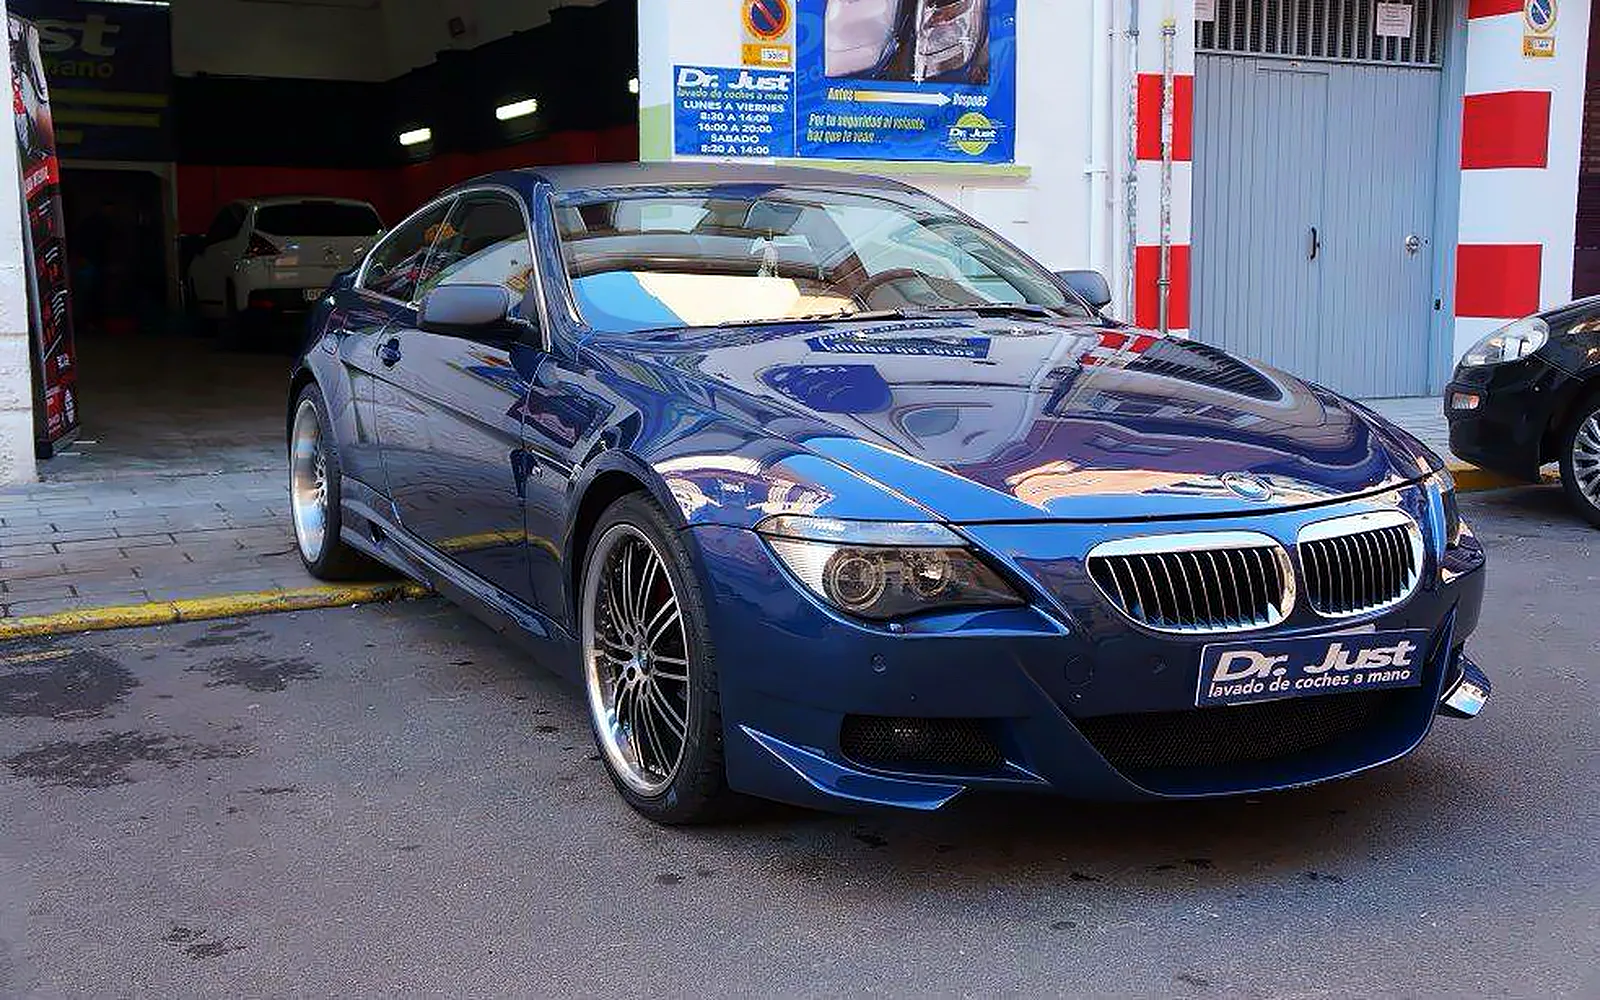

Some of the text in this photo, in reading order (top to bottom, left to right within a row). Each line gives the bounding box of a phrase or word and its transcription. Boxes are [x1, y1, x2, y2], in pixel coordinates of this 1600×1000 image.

[677, 68, 791, 91] Dr. Just
[724, 89, 755, 100] coches
[683, 100, 785, 113] LUNES A VIERNES
[726, 113, 737, 121] A
[698, 123, 772, 133] 16:00 A 20:00
[950, 128, 997, 138] Dr. Just
[727, 145, 737, 154] A
[740, 146, 770, 154] 14:00
[1212, 639, 1417, 682] Dr. Just
[1207, 669, 1411, 698] lavado de coches a mano
